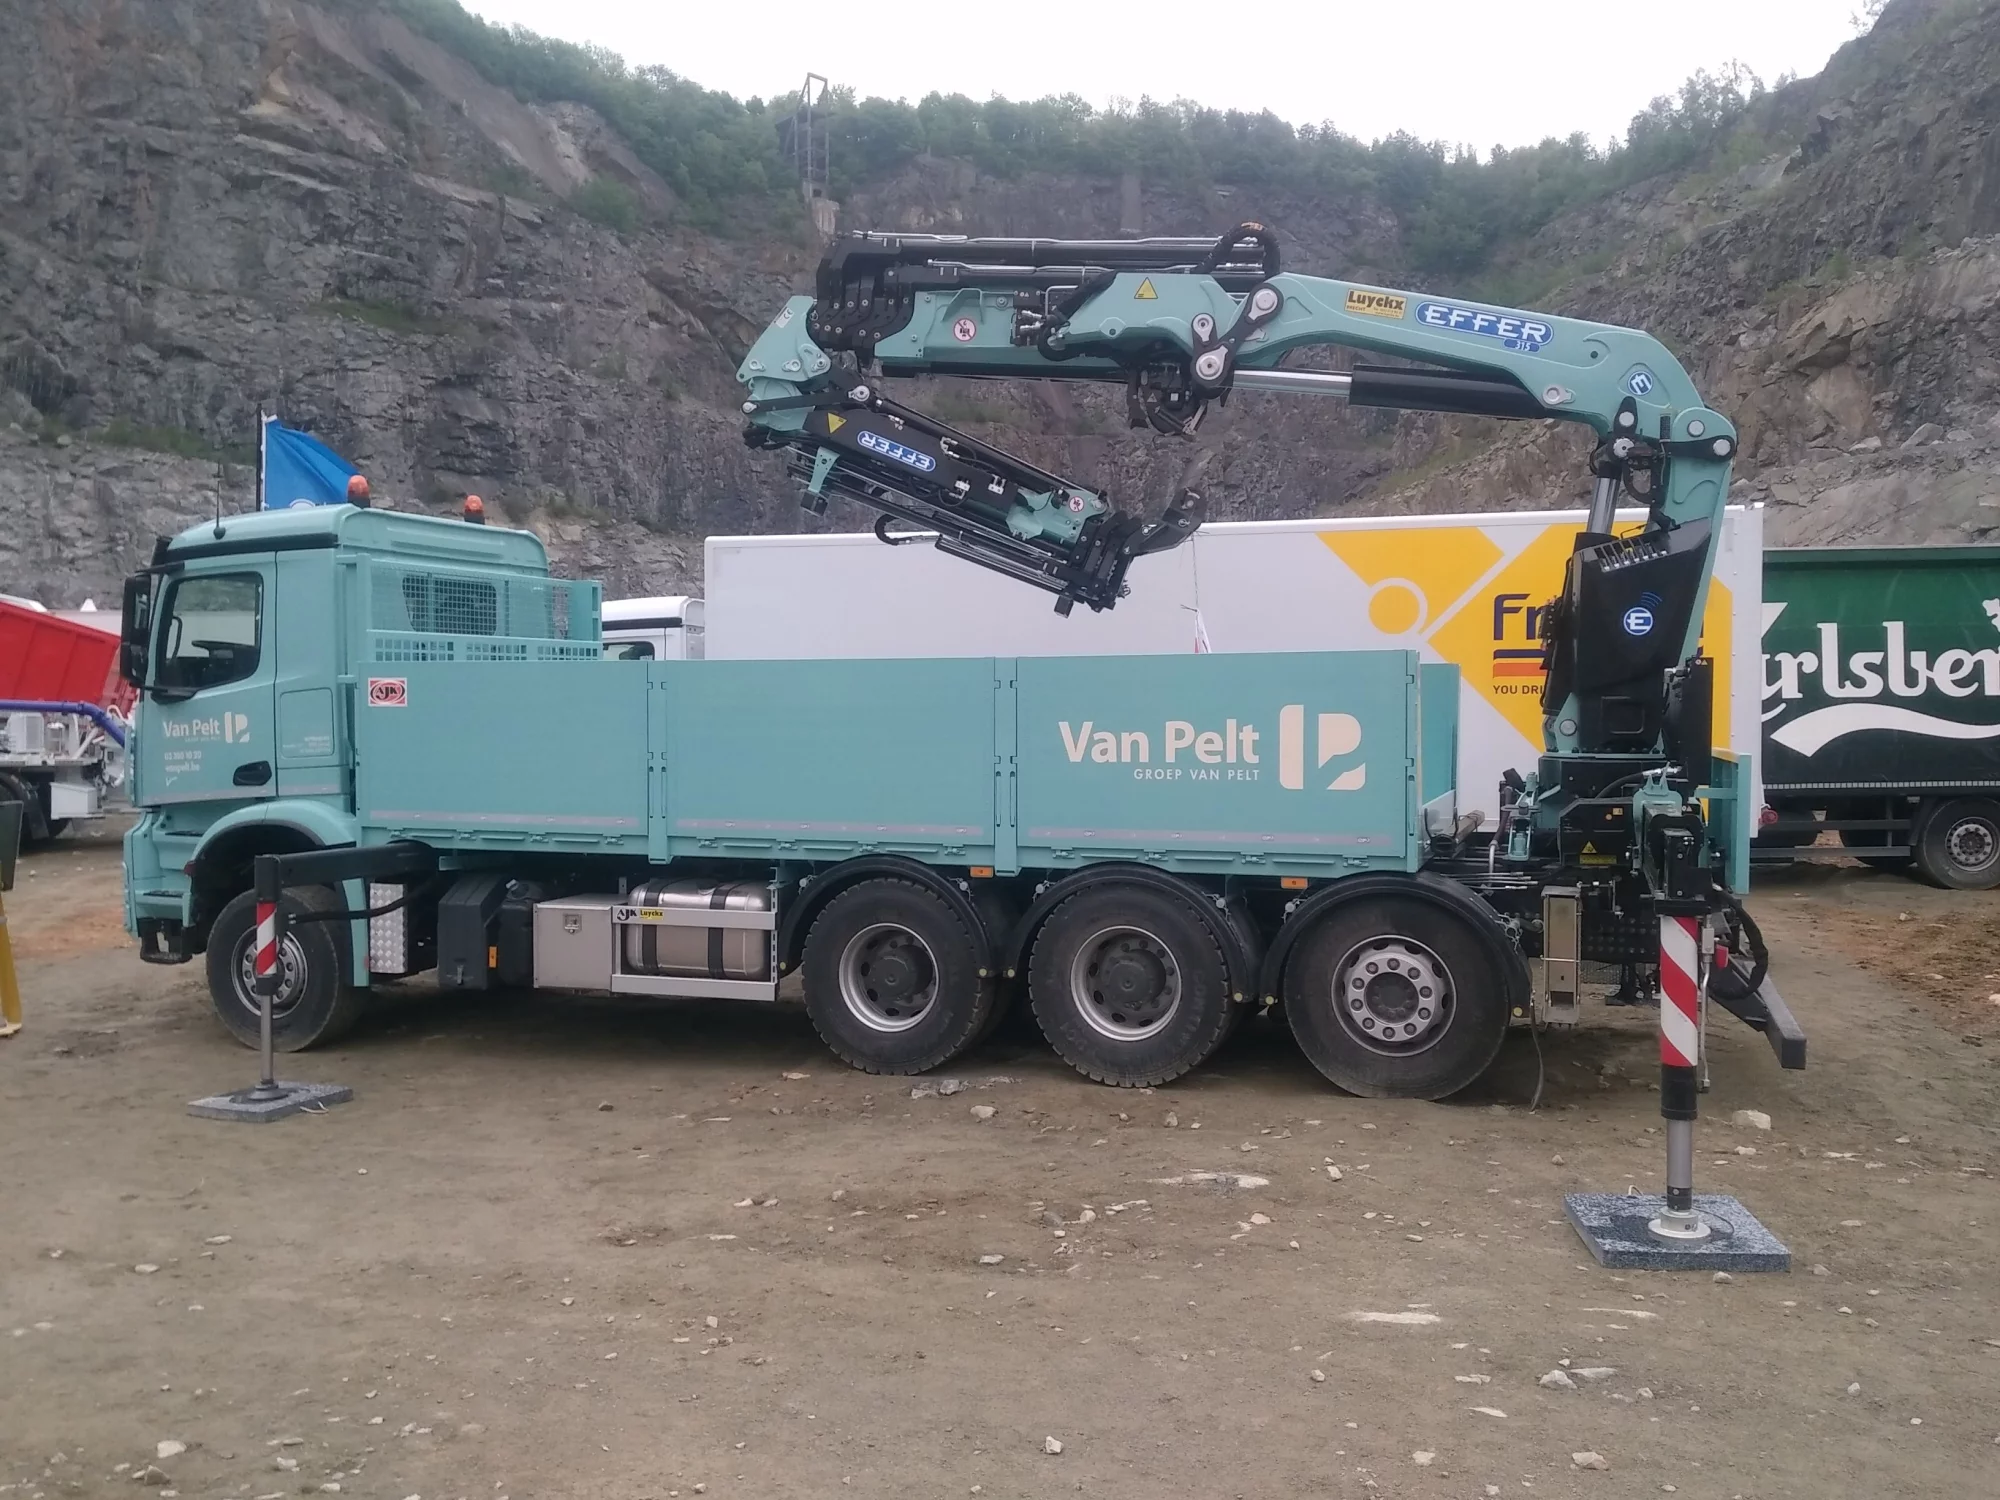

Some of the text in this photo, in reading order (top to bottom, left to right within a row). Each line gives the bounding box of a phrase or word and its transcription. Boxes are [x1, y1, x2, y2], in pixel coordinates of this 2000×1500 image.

[1348, 291, 1404, 311] Luyckx
[1424, 305, 1546, 343] EFFER
[1515, 340, 1531, 351] 315
[861, 433, 931, 469] EFFER
[1761, 602, 2000, 722] rlsber
[374, 686, 398, 701] AJK
[1493, 685, 1543, 695] YOU DRI
[163, 718, 220, 738] Van Pelt
[1058, 718, 1260, 764] Van Pelt
[1133, 768, 1260, 781] GROEP VAN PELT
[617, 909, 664, 921] AJK Luyckx
